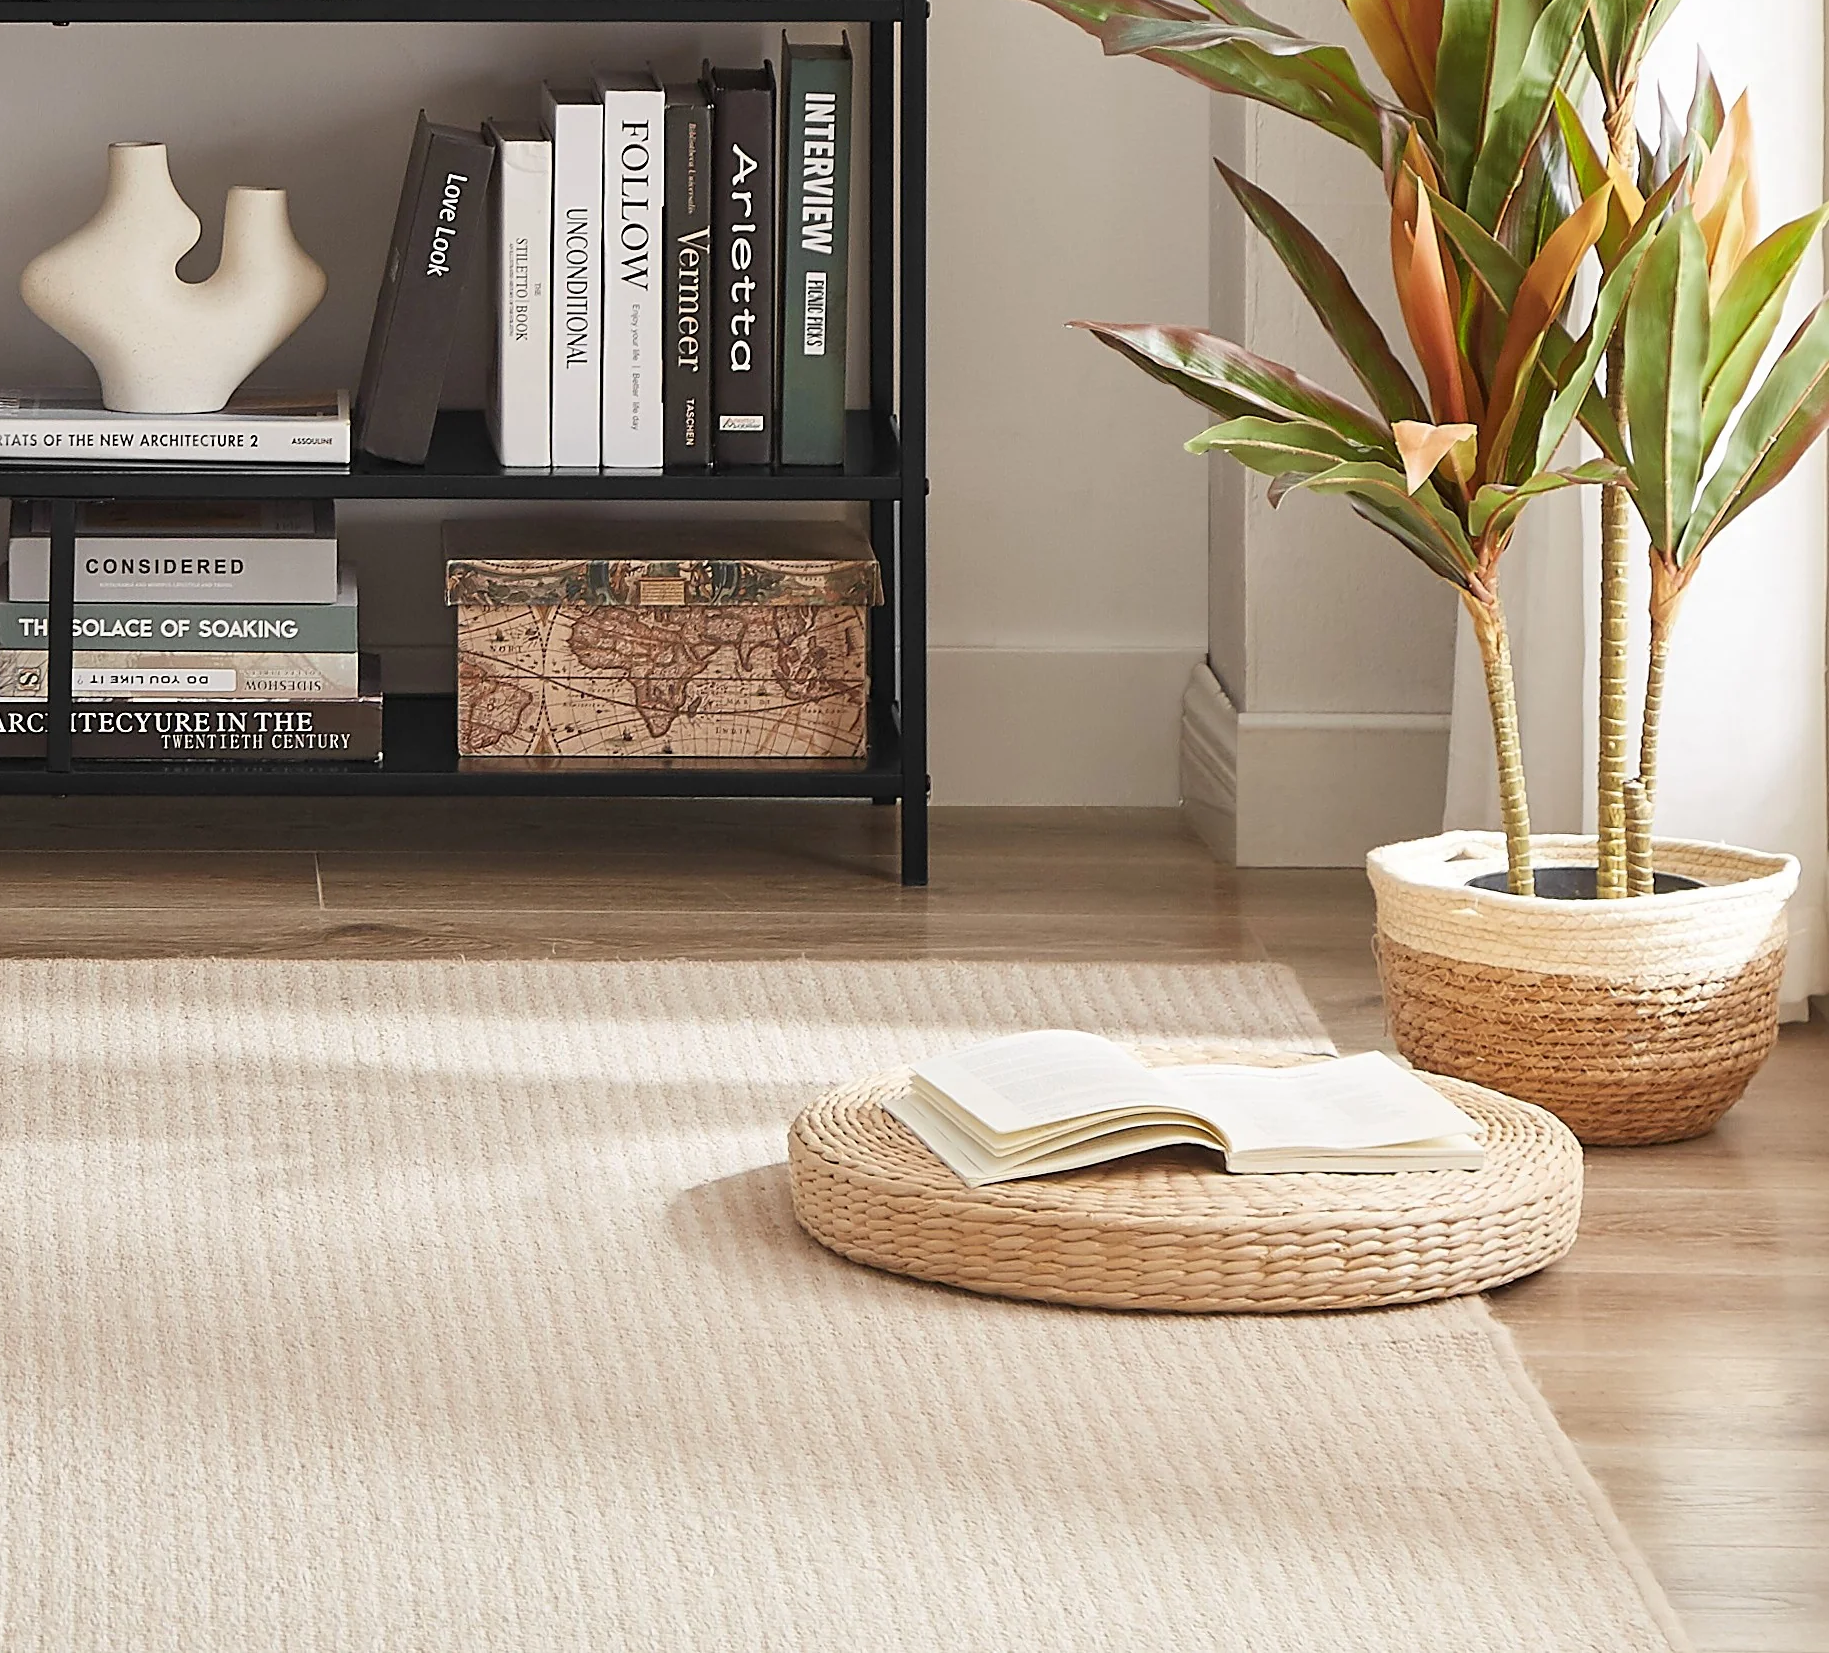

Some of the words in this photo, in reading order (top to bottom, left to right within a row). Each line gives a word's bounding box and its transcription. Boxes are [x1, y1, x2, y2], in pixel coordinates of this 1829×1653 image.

[801, 92, 836, 255] INTERVIEW
[439, 173, 469, 222] Love
[619, 118, 650, 291] FOLLOW
[426, 226, 457, 277] Look
[730, 143, 759, 372] Arletta
[515, 237, 528, 299] STILETTO
[565, 207, 589, 370] UNCONDITIONAL
[677, 225, 710, 373] Vermeer
[515, 305, 528, 341] BOOK
[631, 303, 641, 327] Enjoy
[631, 329, 639, 347] your
[633, 349, 641, 361] life
[632, 373, 641, 398] Better
[632, 402, 641, 413] life
[630, 415, 640, 431] day
[685, 399, 695, 446] TASCHEN
[43, 434, 62, 447] OF
[68, 434, 94, 447] THE
[100, 434, 134, 447] NEW
[139, 434, 245, 448] ARCHITECTURE
[249, 434, 259, 448] 2
[291, 437, 333, 445] ASSOULINE
[85, 558, 245, 575] CONSIDERED
[18, 618, 49, 638] TH
[71, 618, 153, 638] SOLACE
[160, 618, 191, 639] OF
[198, 618, 299, 640] SOAKING
[89, 674, 104, 684] IT
[110, 675, 144, 685] LIKE
[149, 675, 180, 685] YOU
[187, 675, 209, 685] DO
[244, 680, 322, 691] SIDESHOW
[216, 712, 249, 733] IN
[253, 711, 314, 733] THE
[160, 733, 264, 750] TWENTIETH
[271, 732, 352, 749] CENTURY
